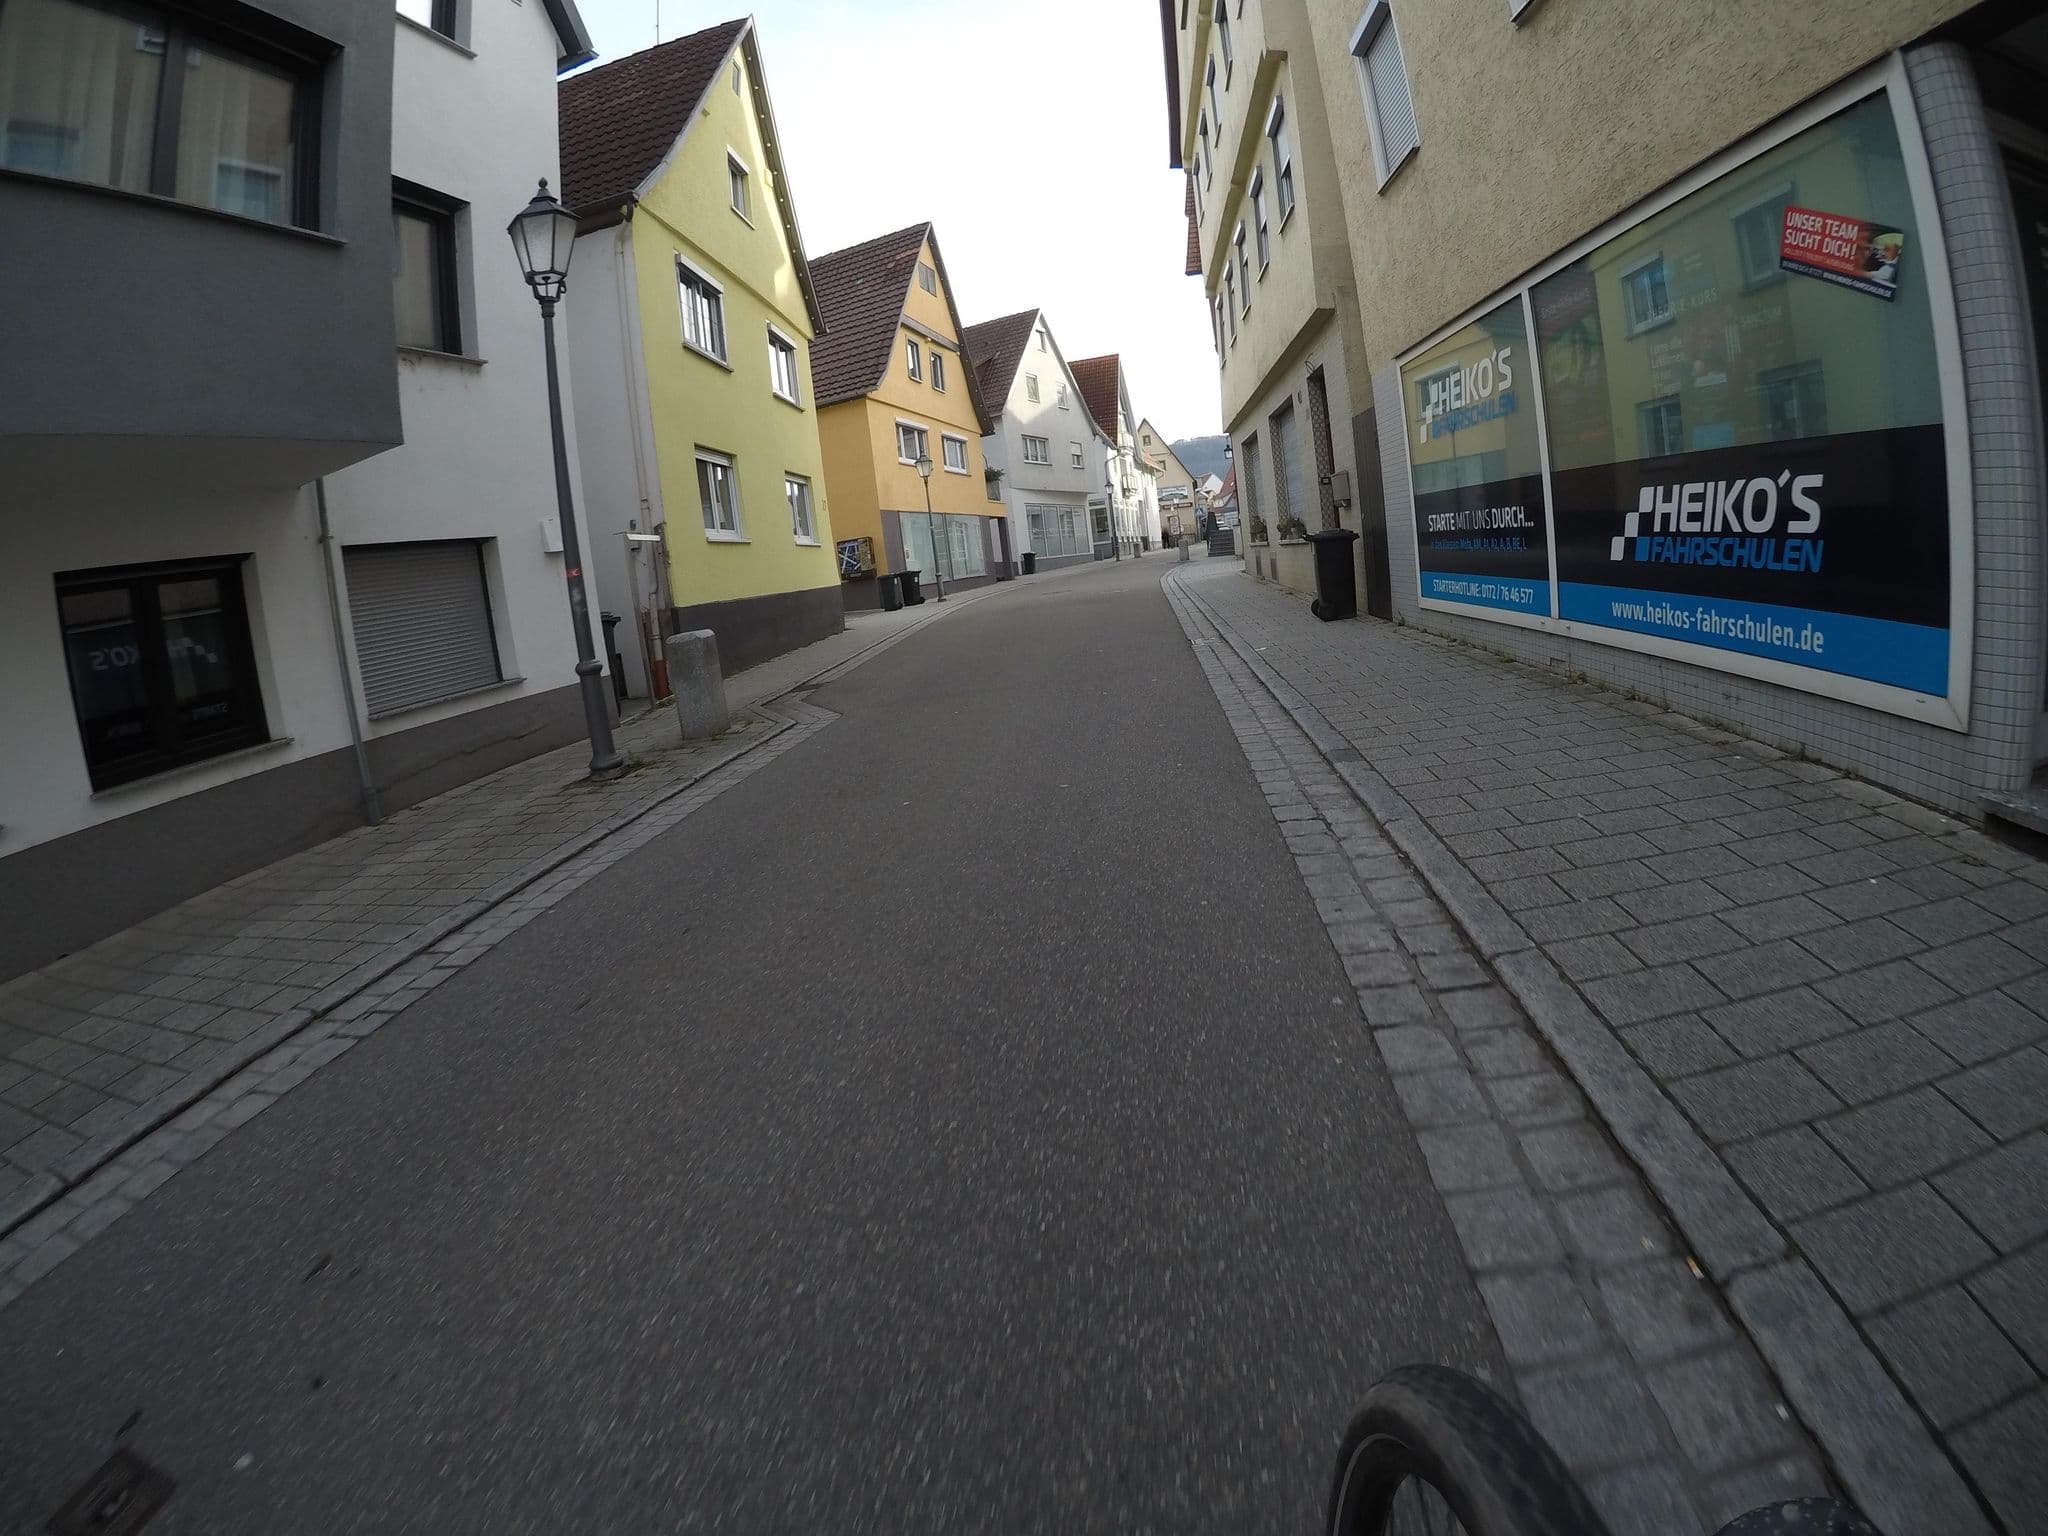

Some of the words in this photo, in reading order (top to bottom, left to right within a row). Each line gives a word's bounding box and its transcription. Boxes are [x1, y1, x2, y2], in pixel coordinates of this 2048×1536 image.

[1787, 212, 1823, 232] UNSER
[1825, 220, 1859, 241] TEAM
[1784, 229, 1821, 250] SUCHT
[1823, 238, 1857, 260] DICH!
[1439, 347, 1512, 414] HEIKO'S
[1653, 469, 1824, 534] HEIKO'S
[1428, 512, 1456, 532] STARTE
[1456, 510, 1471, 530] MIT
[1472, 508, 1491, 530] UNS
[1491, 506, 1534, 529] DURCH...
[1651, 536, 1824, 573] FAHRSCHULEN
[1433, 579, 1481, 597] STARTERHOTLINE:
[1481, 583, 1496, 600] 0172
[1501, 586, 1509, 601] 76
[1510, 587, 1520, 603] 46
[1520, 588, 1534, 604] 577
[1612, 601, 1824, 653] www.heikos-fahrschulen.de
